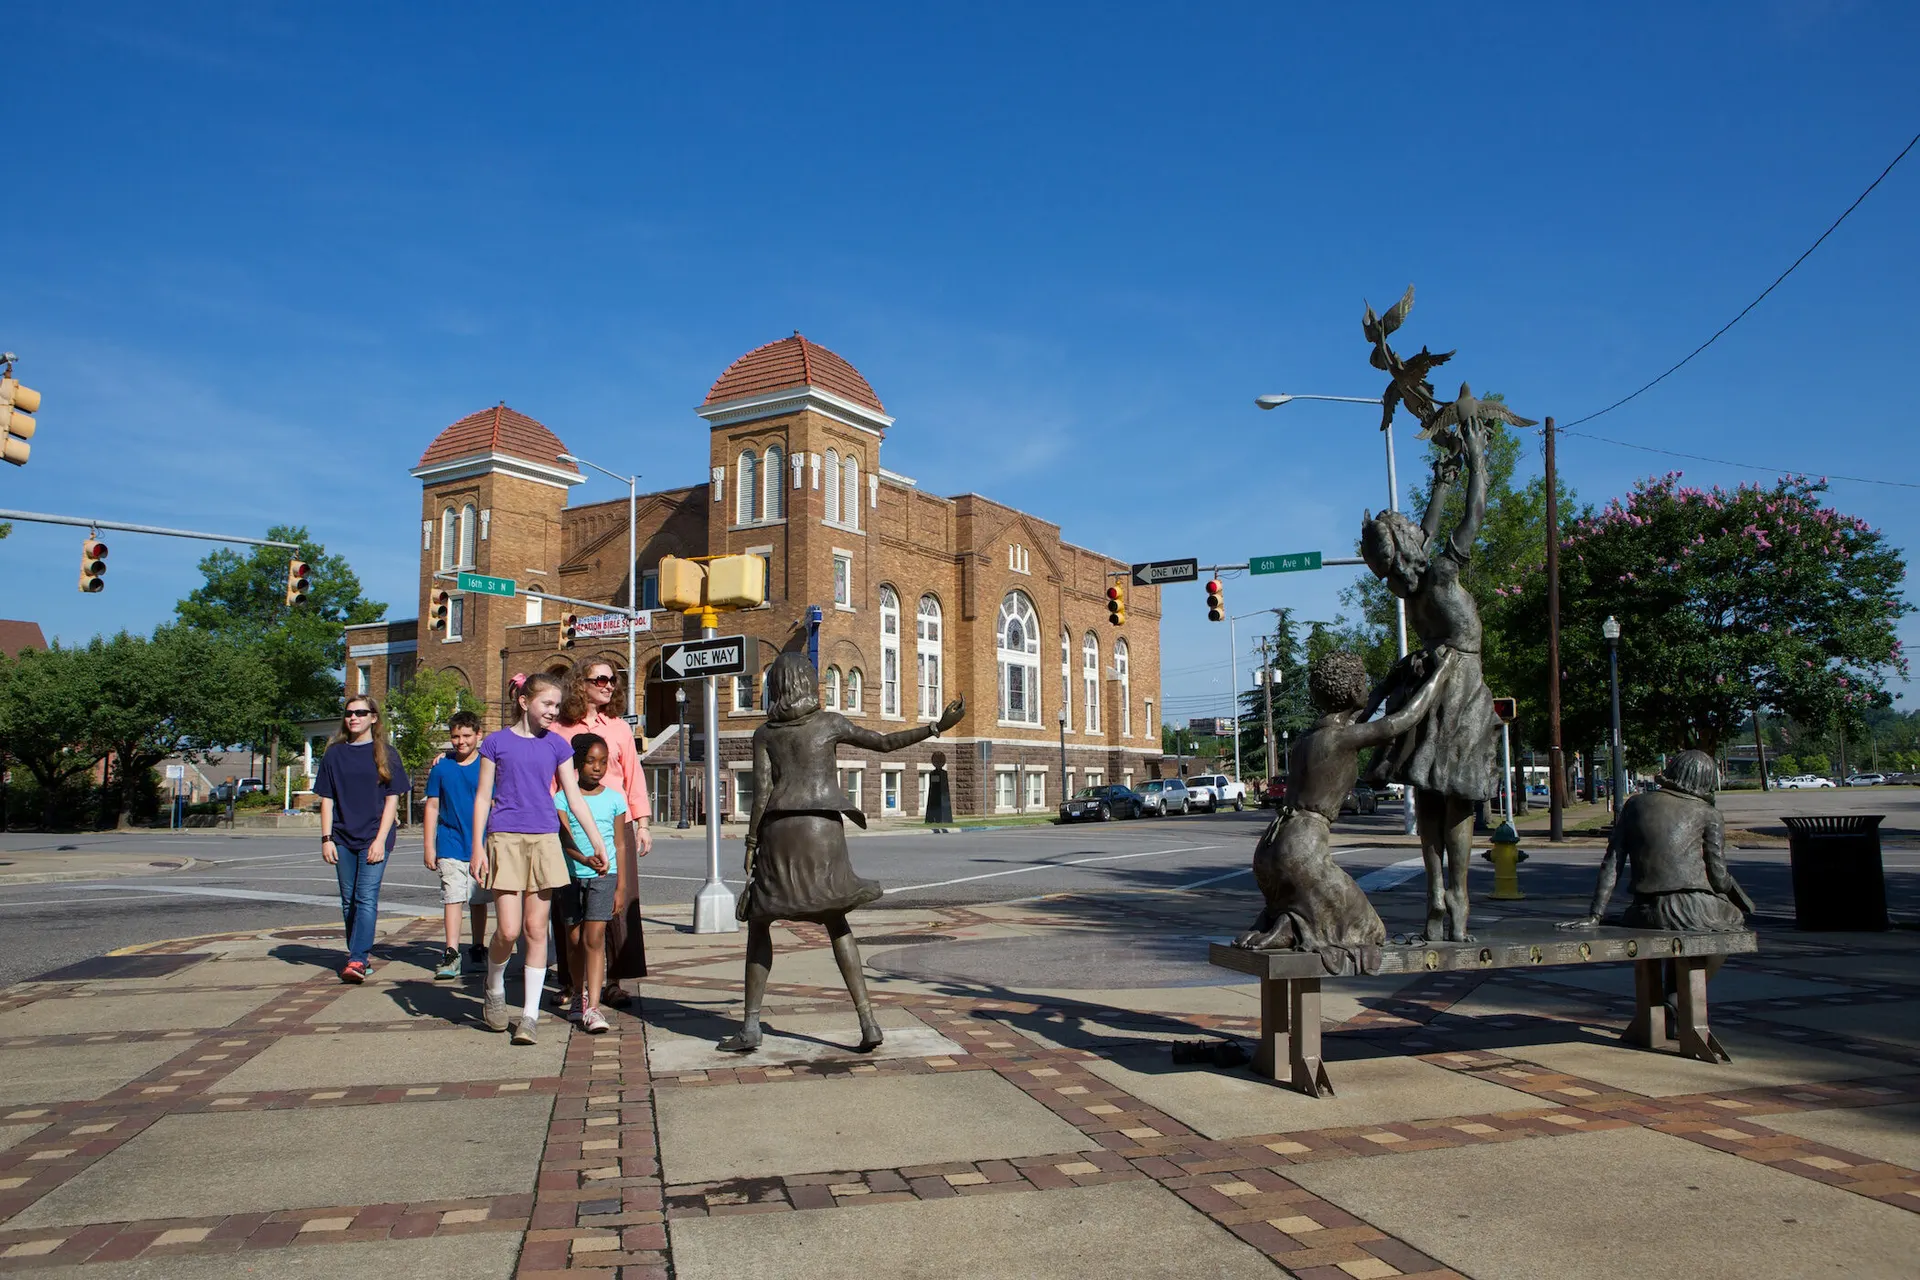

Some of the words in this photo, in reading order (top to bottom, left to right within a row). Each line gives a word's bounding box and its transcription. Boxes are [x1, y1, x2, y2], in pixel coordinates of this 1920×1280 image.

[1261, 561, 1274, 571] 6th
[1282, 559, 1297, 569] Ave
[1304, 557, 1311, 566] N
[1151, 567, 1168, 578] ONE
[1171, 565, 1190, 576] WAY
[468, 578, 483, 589] 16th
[488, 580, 496, 591] St
[501, 583, 506, 592] N
[603, 619, 620, 630] BIBLE
[621, 616, 646, 629] SCOOL
[685, 651, 708, 668] ONE
[711, 648, 735, 665] WAY
